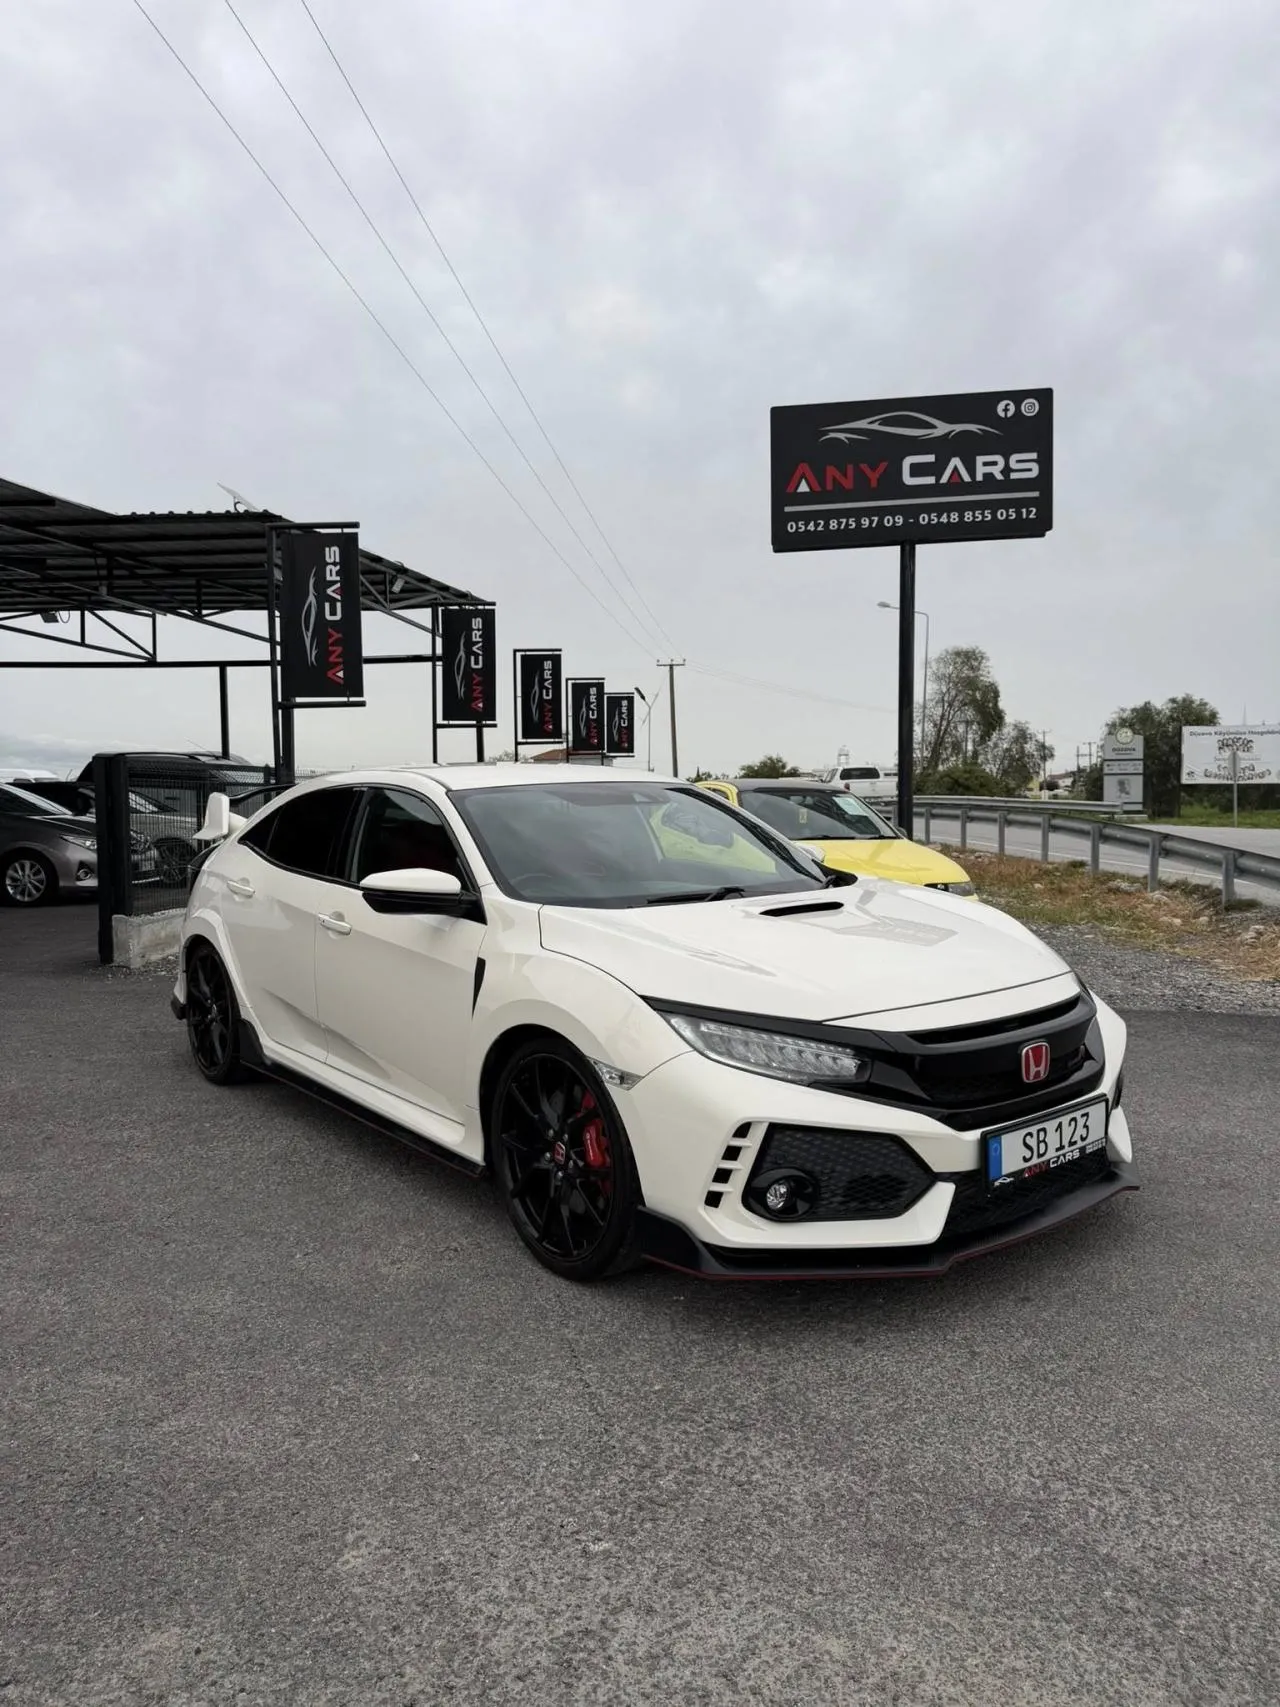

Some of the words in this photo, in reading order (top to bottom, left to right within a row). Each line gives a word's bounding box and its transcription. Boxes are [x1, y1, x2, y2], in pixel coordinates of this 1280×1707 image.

[785, 461, 889, 493] ANY
[902, 452, 1040, 486] CARS
[787, 519, 825, 533] 0542
[829, 517, 856, 530] 875
[860, 516, 879, 528] 97
[884, 514, 904, 527] 09
[919, 511, 959, 525] 0548
[963, 509, 992, 522] 855
[997, 508, 1016, 520] 05
[1021, 507, 1037, 519] 12
[324, 545, 342, 621] CARS
[326, 627, 344, 685] ANY
[470, 617, 483, 669] CARS
[471, 673, 483, 712] ANY
[542, 660, 552, 700] CARS
[543, 702, 553, 732] ANY
[589, 687, 597, 719] CARS
[620, 699, 628, 727] CARS
[1022, 1126, 1049, 1163] SB
[1054, 1111, 1090, 1152] 123
[1023, 1161, 1049, 1178] ANY
[1049, 1149, 1080, 1168] CARS
